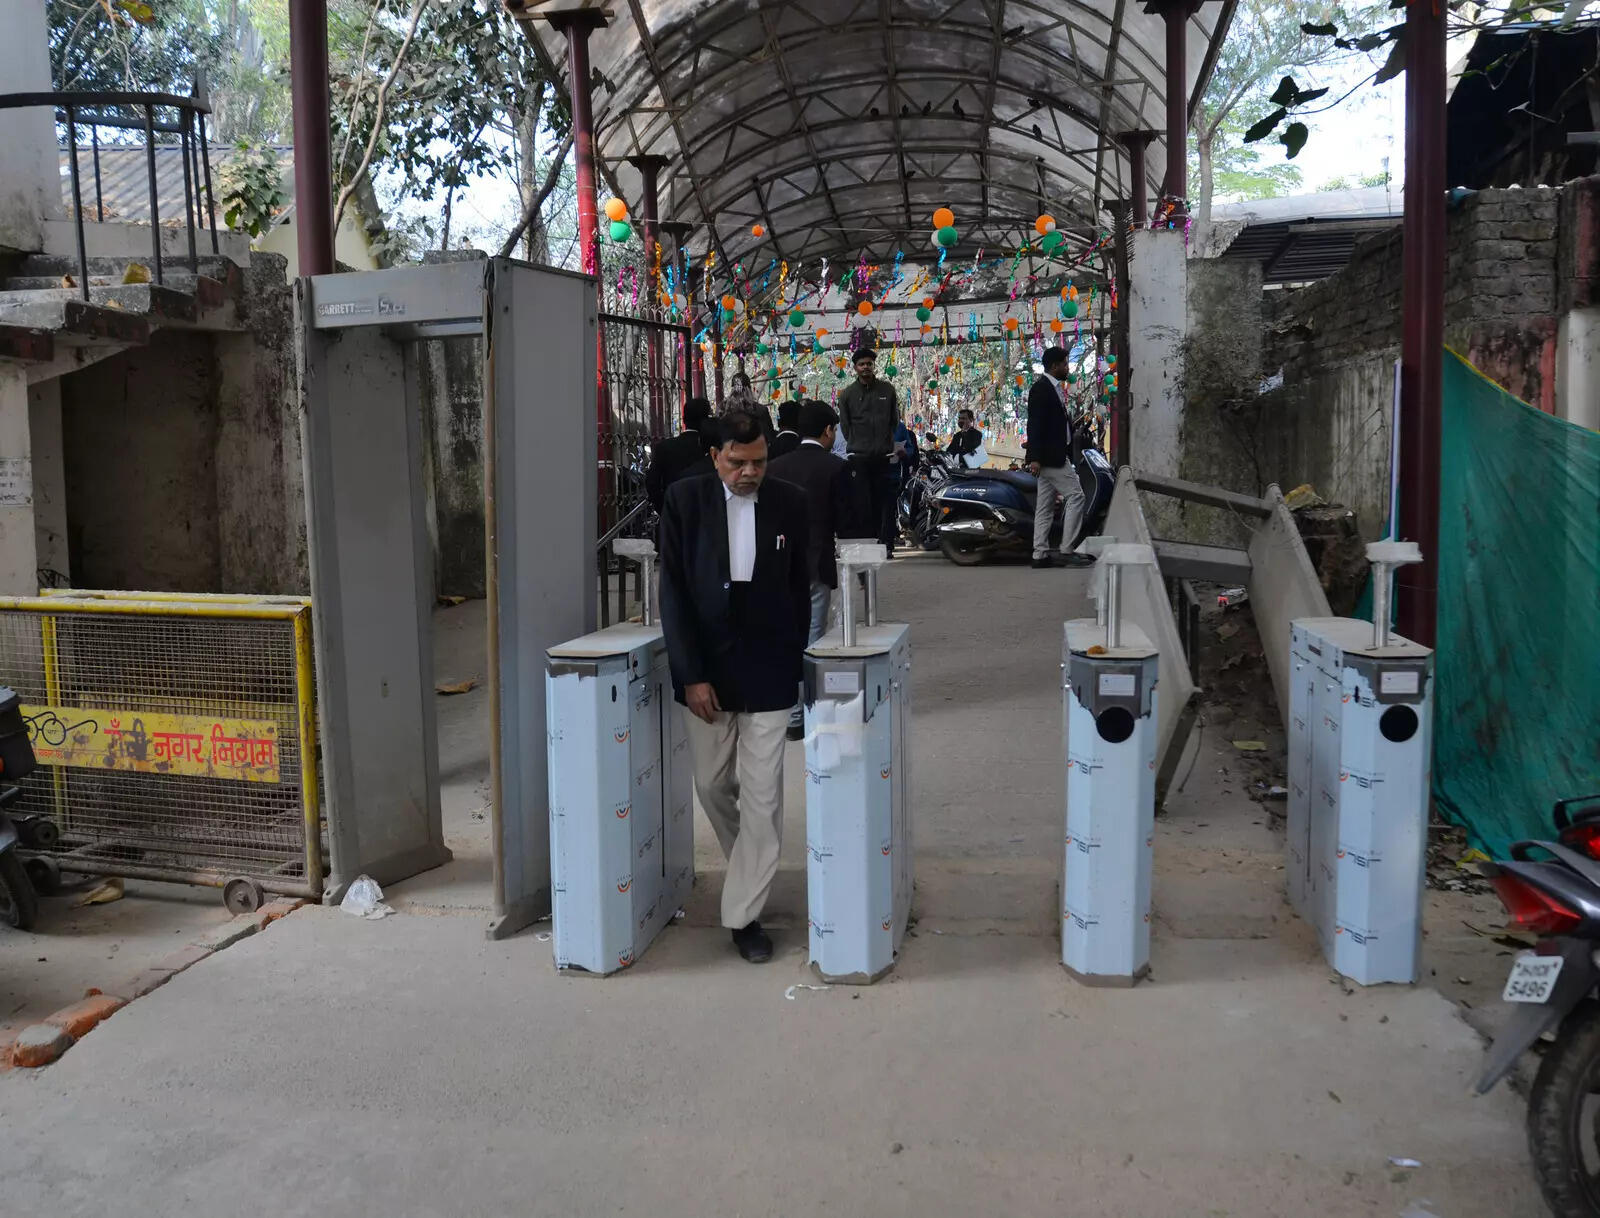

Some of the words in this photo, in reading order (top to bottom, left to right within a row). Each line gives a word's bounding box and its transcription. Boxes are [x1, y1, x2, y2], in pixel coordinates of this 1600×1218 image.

[318, 302, 355, 316] GARRETT
[152, 732, 204, 764] नगर
[210, 723, 273, 768] निगम
[1509, 981, 1548, 998] 5496
